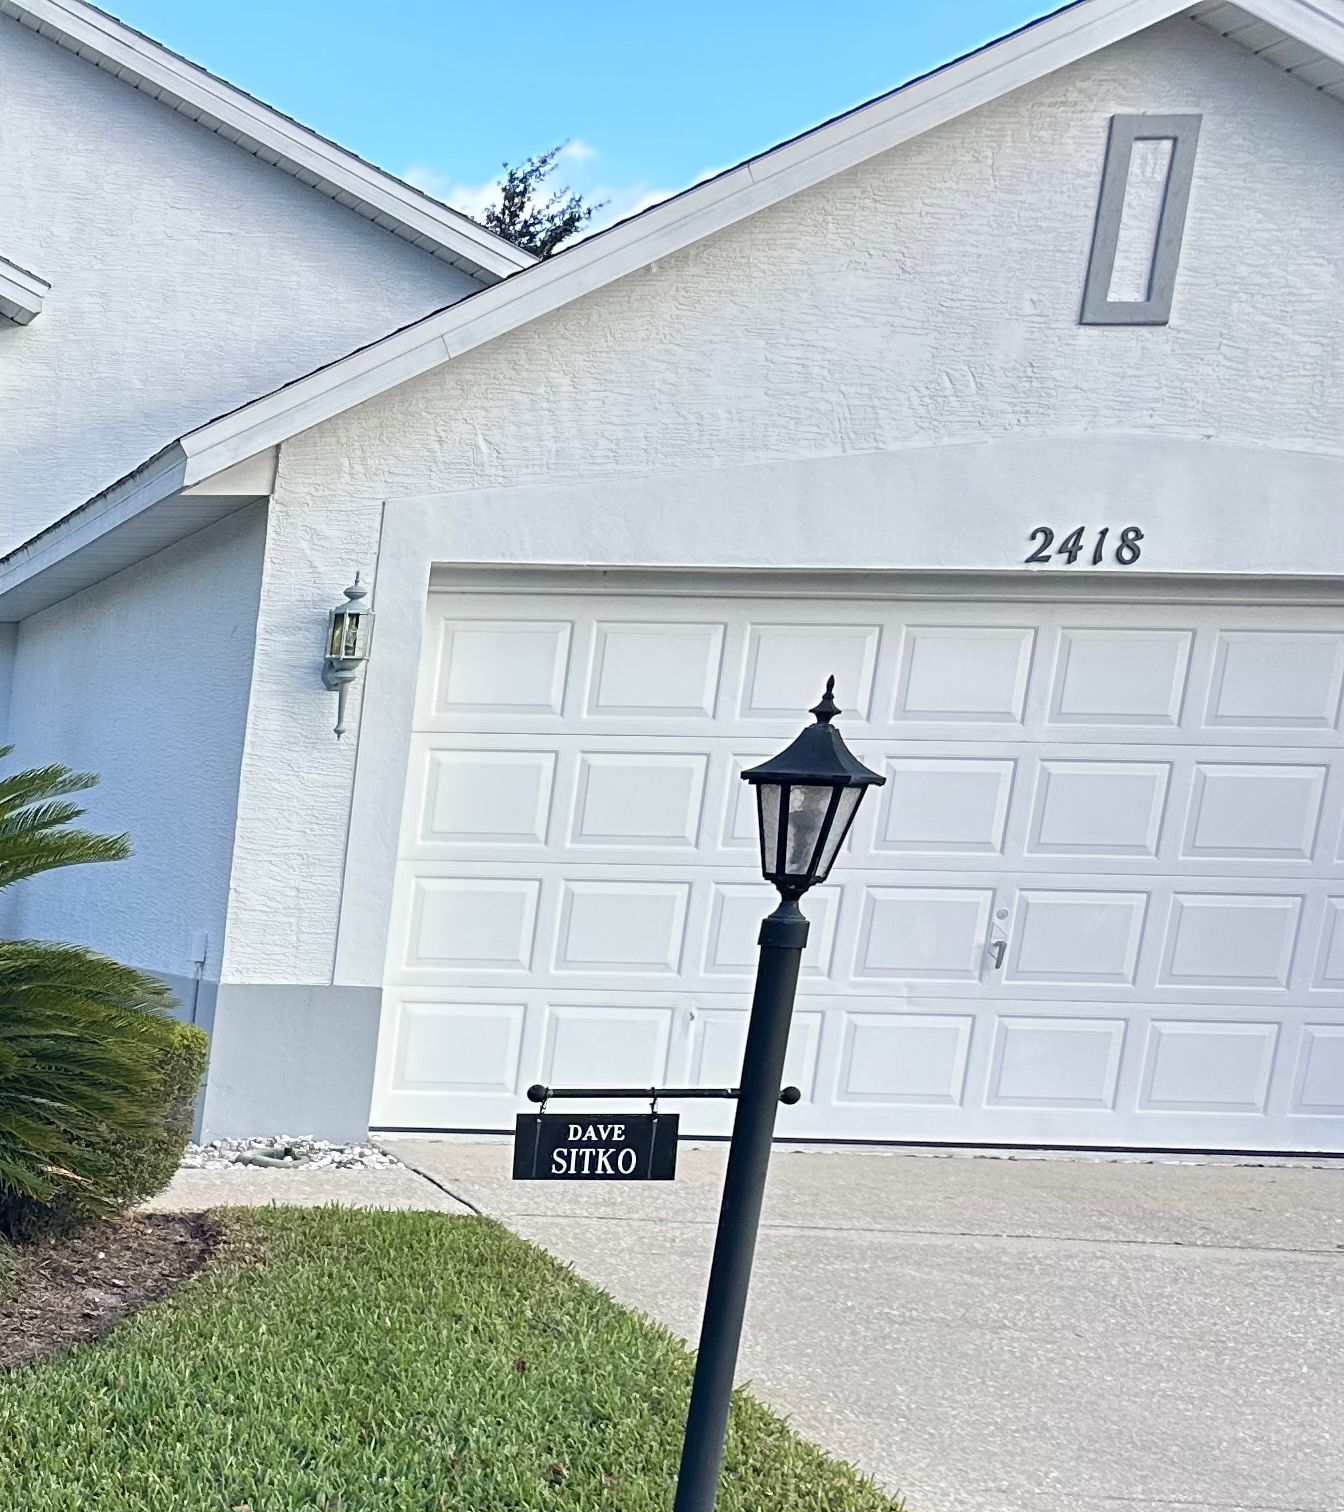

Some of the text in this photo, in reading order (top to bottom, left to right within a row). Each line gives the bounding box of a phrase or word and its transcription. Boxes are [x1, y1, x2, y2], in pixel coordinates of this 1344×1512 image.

[1024, 526, 1144, 565] 2418
[567, 1124, 626, 1141] DAVE
[551, 1148, 637, 1174] SITKO
